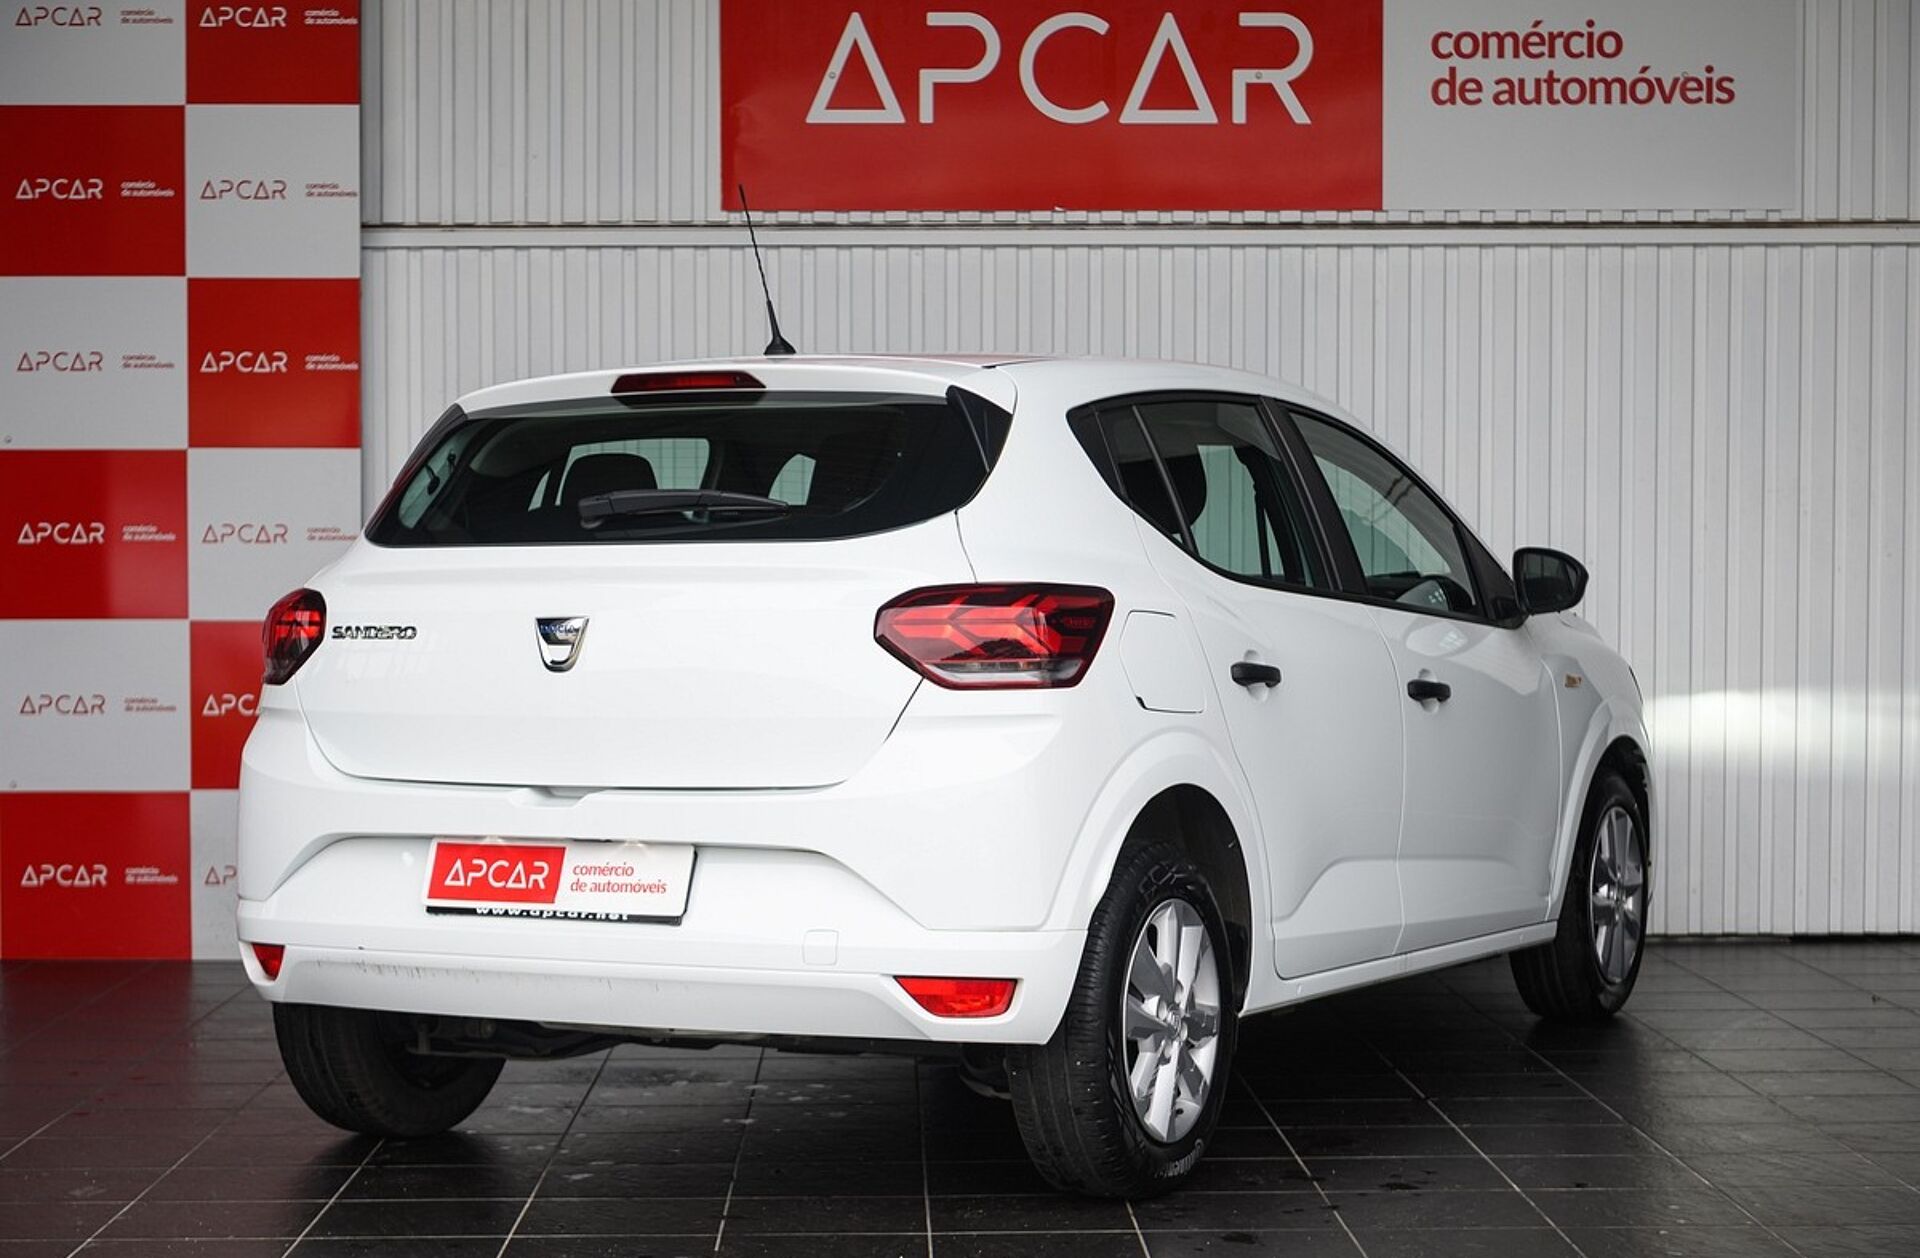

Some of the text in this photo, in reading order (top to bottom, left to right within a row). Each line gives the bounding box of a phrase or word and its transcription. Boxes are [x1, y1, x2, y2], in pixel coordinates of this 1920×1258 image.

[15, 7, 101, 26] APCAR
[200, 7, 286, 27] APCAR
[1431, 19, 1624, 59] comércio
[806, 11, 1314, 125] APCAR
[1431, 65, 1736, 106] de automóveis
[16, 179, 103, 199] APCAR
[200, 180, 286, 200] APCAR
[17, 352, 103, 372] APCAR
[200, 352, 287, 372] APCAR
[18, 523, 104, 543] APCAR
[202, 524, 288, 543] APCAR
[332, 625, 417, 640] SANDERO
[20, 695, 105, 714] APCAR
[21, 864, 107, 887] APCAR
[444, 858, 550, 890] APCAR
[572, 862, 634, 878] comércio
[570, 878, 668, 895] de automóveis
